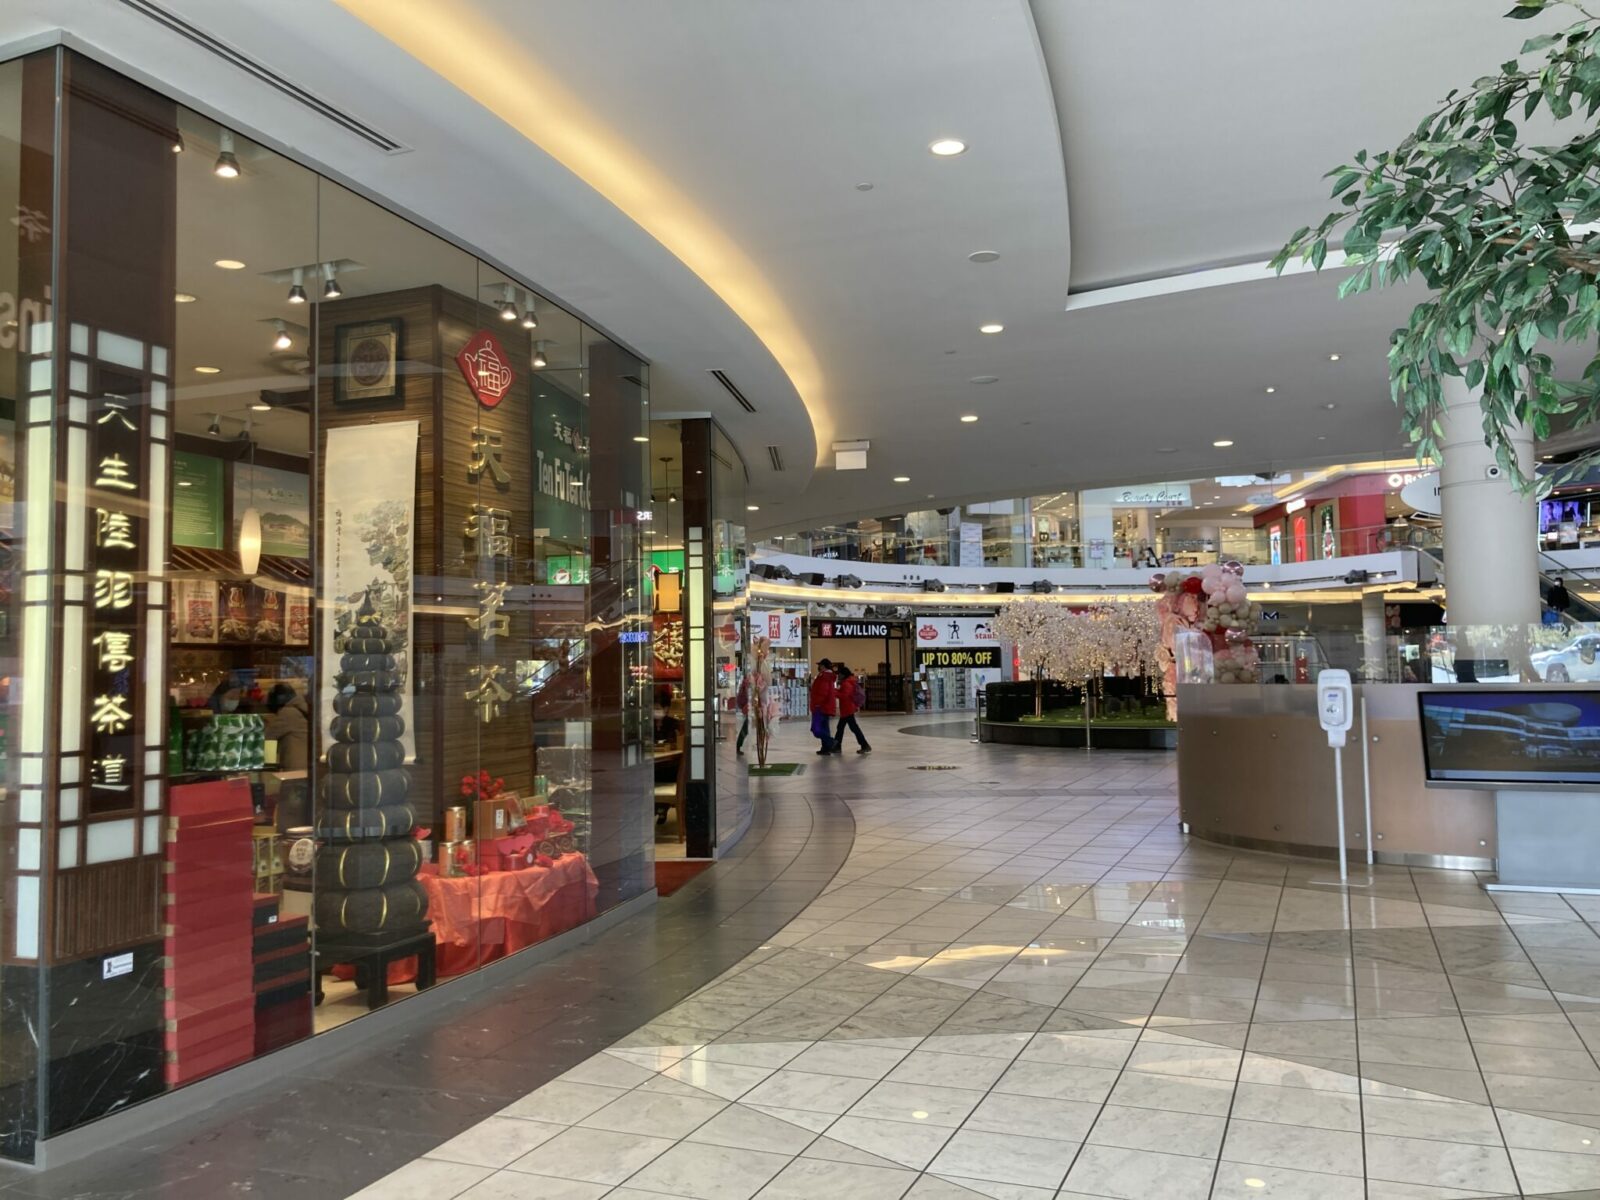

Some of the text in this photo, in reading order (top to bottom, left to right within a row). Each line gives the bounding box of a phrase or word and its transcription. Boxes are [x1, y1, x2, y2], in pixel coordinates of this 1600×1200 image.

[835, 624, 888, 636] ZWILLING
[922, 651, 992, 665] UP TO 80% OFF
